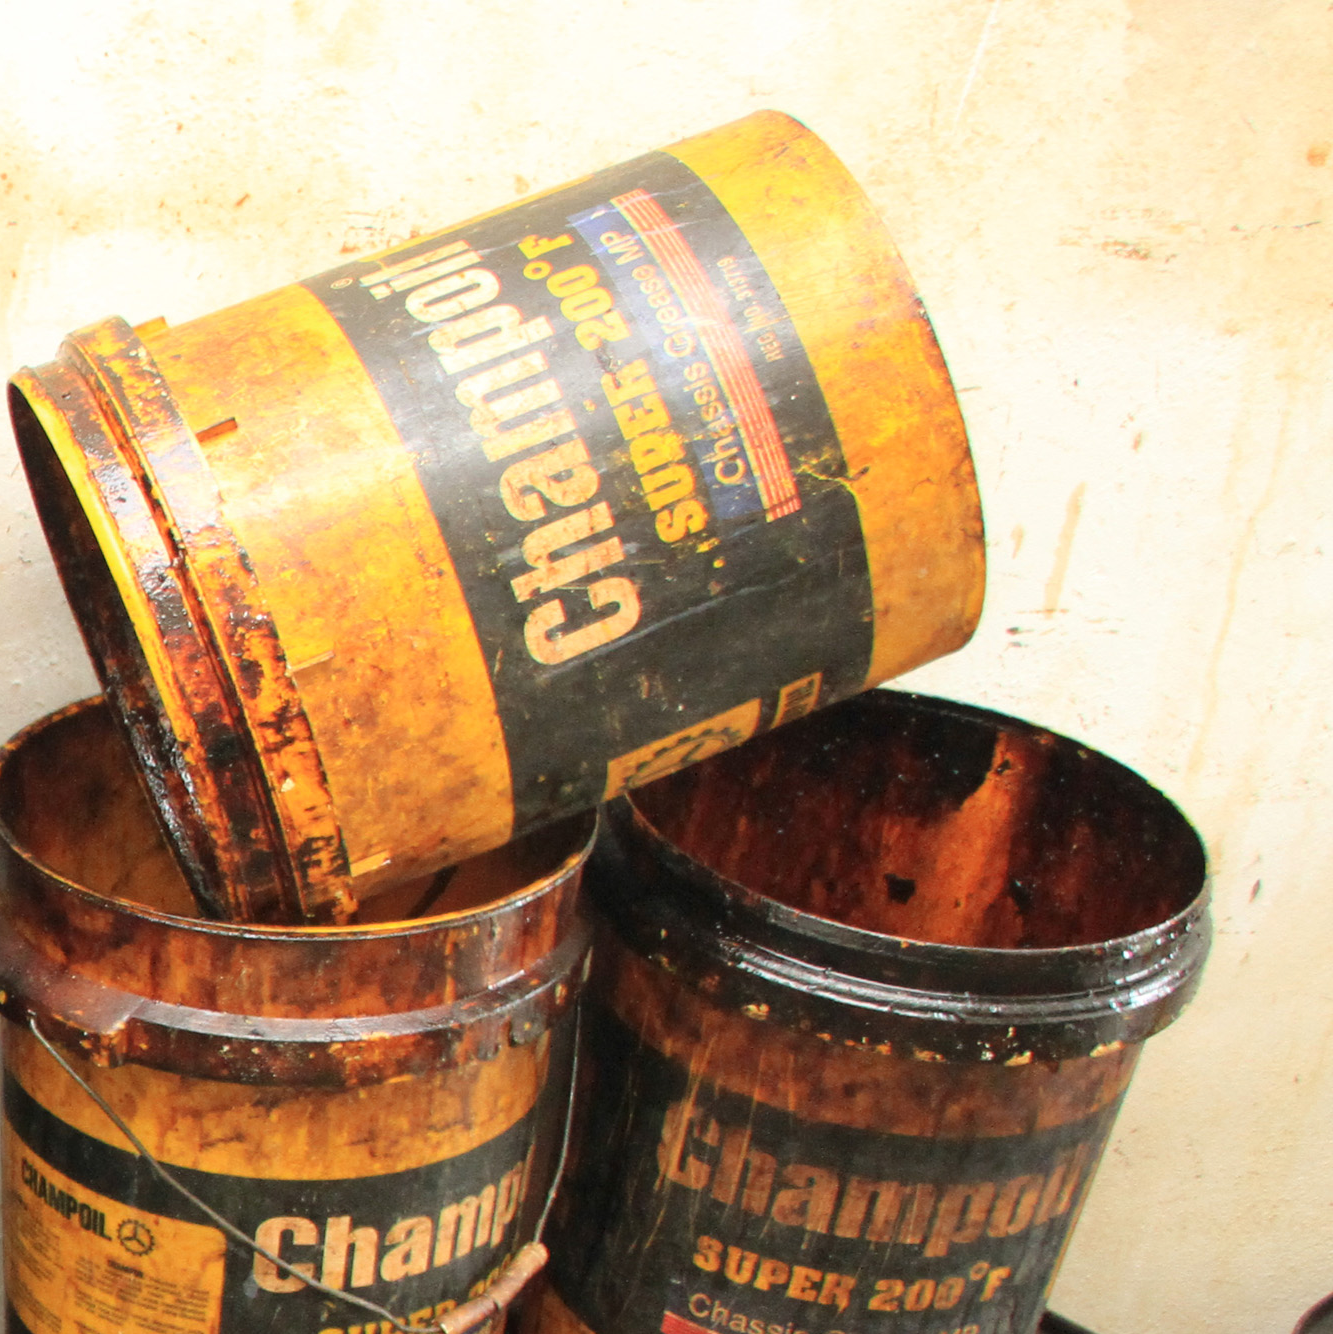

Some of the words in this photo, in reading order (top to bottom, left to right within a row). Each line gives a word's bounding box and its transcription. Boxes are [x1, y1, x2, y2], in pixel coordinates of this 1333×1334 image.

[599, 230, 644, 266] MP
[632, 264, 697, 358] Grease
[359, 240, 643, 666] Champoil
[600, 358, 709, 544] SUPER
[682, 360, 747, 485] Chassis
[21, 1158, 113, 1242] CHAMPOIL
[252, 1143, 536, 1294] Champ
[692, 1235, 856, 1313] SUPER
